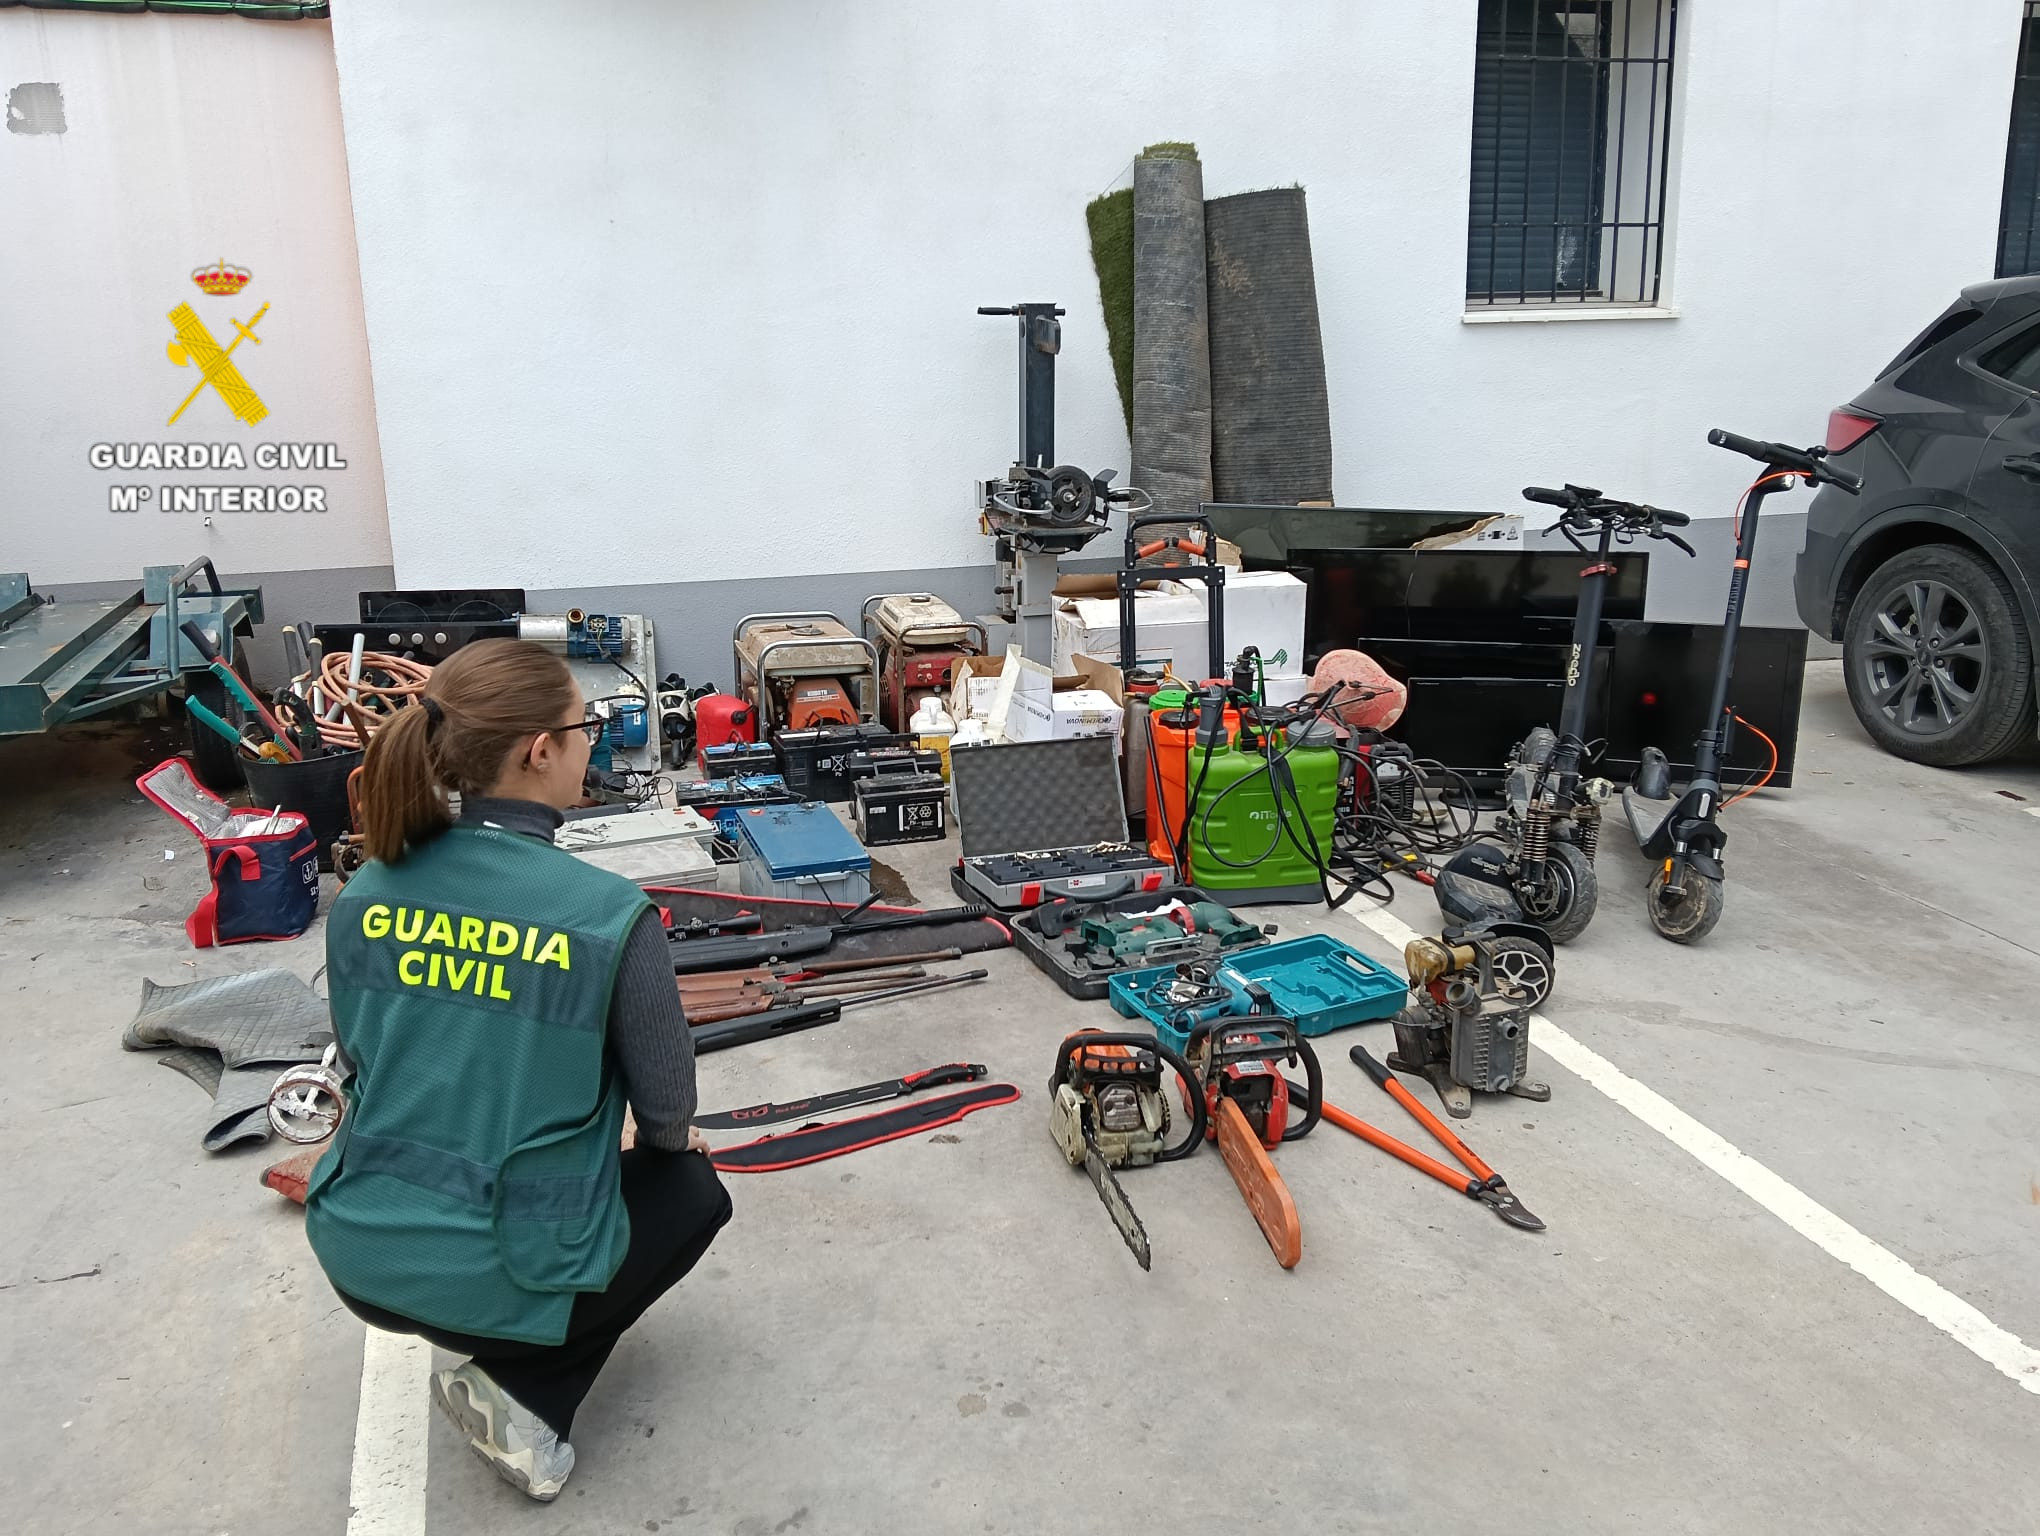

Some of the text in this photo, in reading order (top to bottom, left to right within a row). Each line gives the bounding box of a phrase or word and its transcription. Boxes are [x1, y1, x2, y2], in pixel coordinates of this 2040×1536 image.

[1260, 809, 1292, 820] iTols
[362, 904, 571, 970] GUARDIA
[398, 950, 512, 1001] CIVIL
